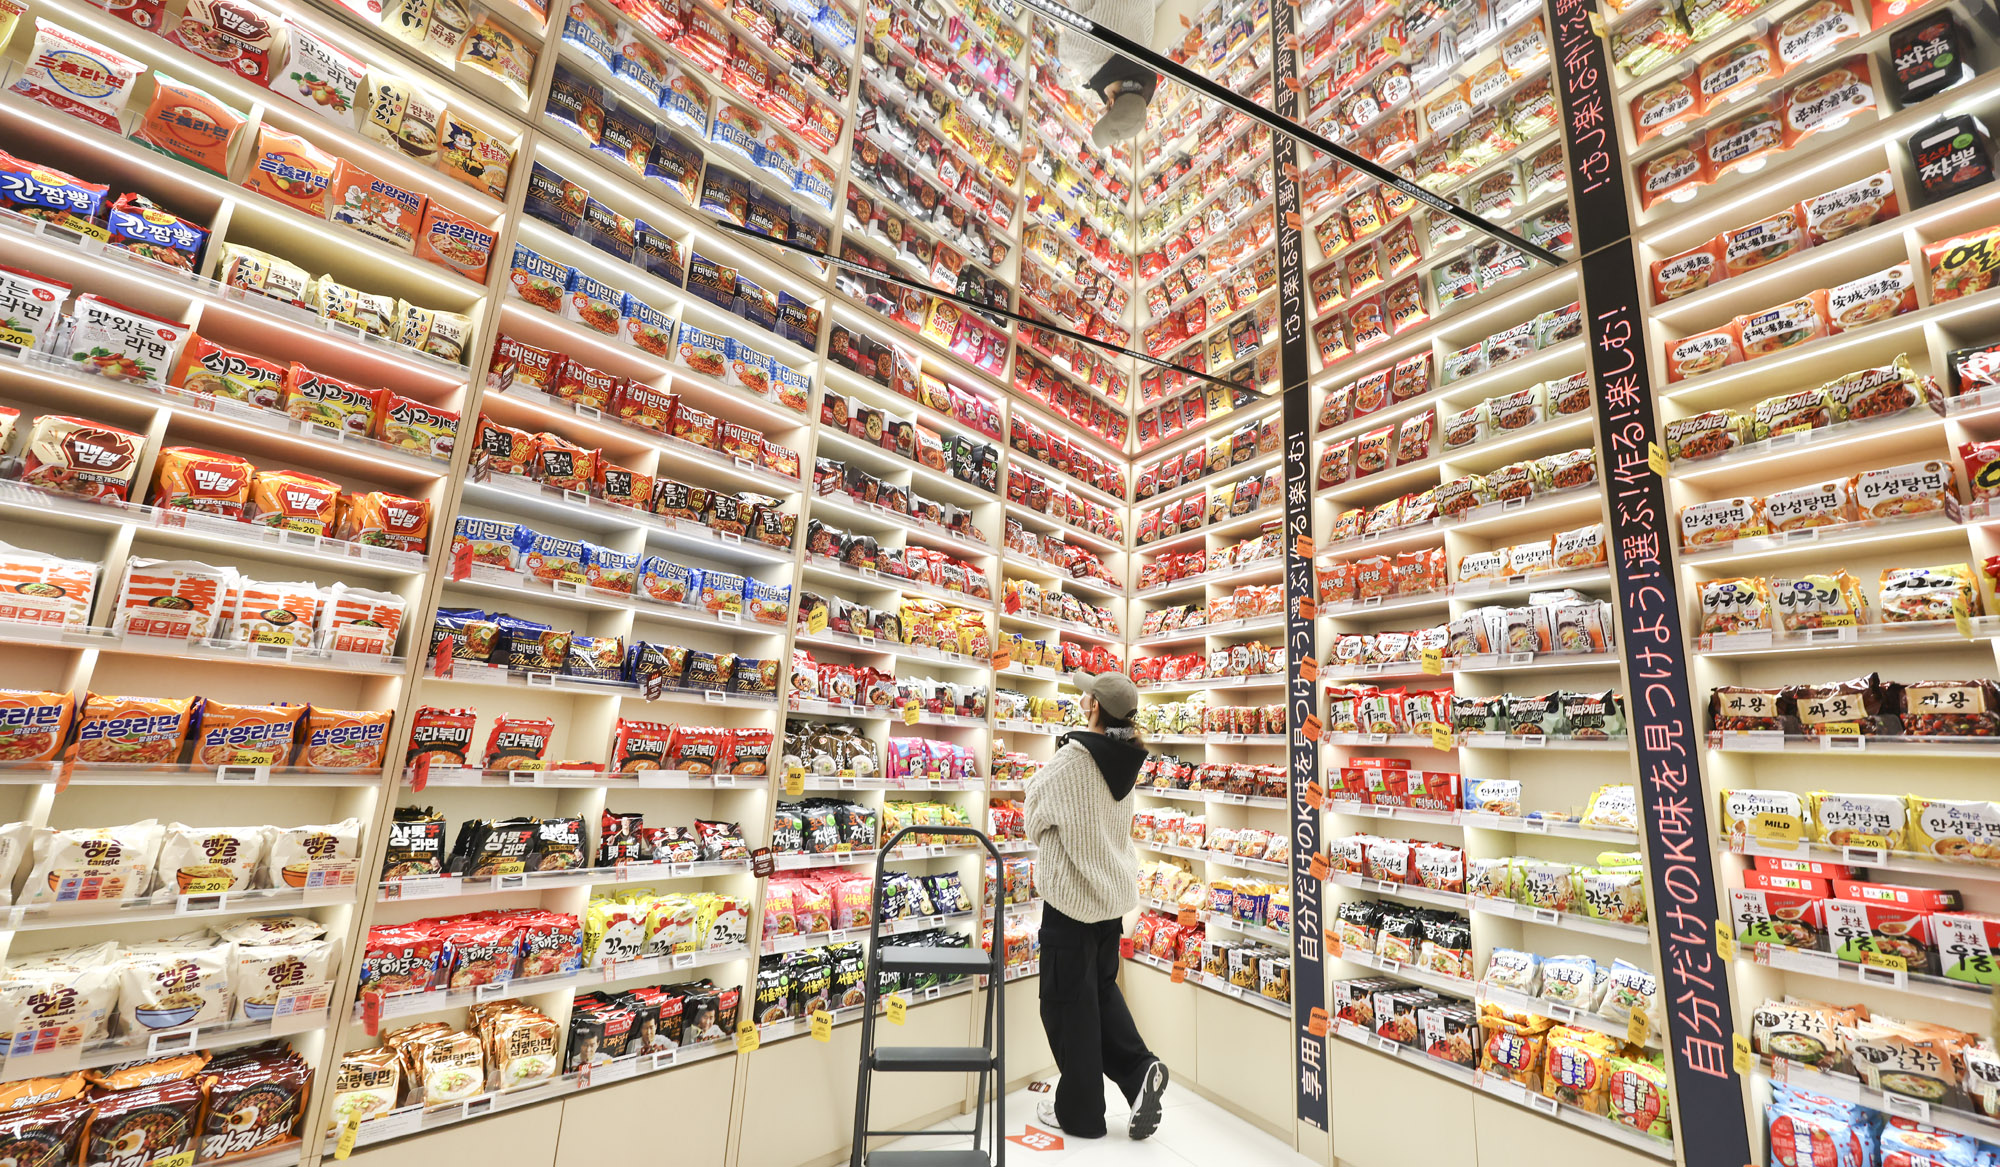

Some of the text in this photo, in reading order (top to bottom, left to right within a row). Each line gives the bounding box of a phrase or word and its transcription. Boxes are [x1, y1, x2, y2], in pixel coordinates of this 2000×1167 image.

[219, 7, 259, 35] 맵탱
[298, 38, 358, 95] 맛있는 라면
[409, 102, 437, 124] 짬뽕
[1920, 147, 1977, 181] 짬뽕
[0, 173, 93, 211] 간짬뽕
[370, 180, 420, 211] 삼양라면
[115, 216, 195, 248] 간짬뽕
[431, 221, 494, 247] 삼양라면
[526, 254, 568, 286] 비빔면
[584, 280, 623, 311] 비빔면
[435, 320, 463, 340] 짬뽕
[639, 306, 672, 336] 비빔면
[87, 307, 167, 361] 맛있는 라면
[690, 330, 726, 355] 비빔면
[509, 343, 550, 371] 비빔면
[743, 351, 773, 377] 비빔면
[201, 351, 283, 390] 쇠고기면
[573, 367, 612, 392] 비빔면
[301, 377, 373, 413] 쇠고기면
[1830, 364, 1901, 404] 짜파게티
[634, 388, 672, 414] 비빔면
[1756, 392, 1826, 423] 짜파게티
[390, 402, 460, 433] 쇠고기면
[1667, 412, 1728, 440] 짜파게티
[74, 440, 124, 468] 맵탱
[194, 468, 237, 494] 맵탱
[1863, 474, 1941, 499] 안성탕면
[286, 490, 324, 513] 맵탱
[1769, 493, 1839, 517] 안성탕면
[388, 505, 421, 529] 맵탱
[1684, 509, 1746, 528] 안성탕면
[466, 519, 516, 543] 비빔면
[541, 535, 584, 559] 비빔면
[601, 549, 637, 572] 비빔면
[712, 572, 745, 593] 비빔면
[1702, 589, 1756, 607] 너구리
[1777, 587, 1841, 607] 너구리
[1425, 654, 1438, 662] MILD
[1453, 704, 1491, 719] 짜파게티
[1508, 699, 1550, 716] 짜파게티
[1564, 702, 1606, 719] 짜파게티
[1728, 698, 1766, 712] 짜왕
[1806, 698, 1852, 718] 짜왕
[80, 714, 182, 739] 삼양라면
[205, 721, 293, 746] 삼양라면
[310, 723, 386, 747] 삼양라면
[422, 726, 470, 745] 라볶이
[1436, 728, 1448, 737] MILD
[506, 733, 546, 750] 라볶이
[690, 742, 720, 762] 라볶이
[1764, 819, 1791, 830] MILD
[1826, 810, 1891, 828] 안성탕면
[1929, 817, 2000, 839] 안성탕면
[80, 838, 125, 860] 탱글
[201, 837, 241, 860] 탱글
[302, 835, 340, 859] 탱글
[411, 838, 439, 852] 라면
[811, 829, 839, 852] 짬뽕
[1314, 857, 1329, 869] MEDIUM
[1421, 859, 1458, 878] 농심라면
[1526, 880, 1559, 904] 칼국수
[1584, 886, 1625, 915] 칼국수
[1737, 913, 1773, 938] 우동
[605, 937, 642, 960] 꼬꼬면
[1834, 926, 1874, 953] 우동
[1945, 943, 1994, 973] 우동
[156, 962, 201, 988] 탱글
[268, 960, 308, 986] 탱글
[1617, 974, 1657, 1000] 백짬뽕
[27, 988, 79, 1014] 탱글
[891, 1001, 903, 1010] MILD
[816, 1017, 829, 1026] MILD
[1311, 1012, 1328, 1022] MEDIUM
[1633, 1014, 1645, 1026] MILD
[1780, 1010, 1829, 1034] 칼국수
[741, 1026, 754, 1036] MILD
[510, 1037, 553, 1060] 설렁탕면
[1736, 1042, 1749, 1054] MILD
[1885, 1043, 1942, 1072] 칼국수
[336, 1065, 391, 1092] 설렁탕면
[202, 1119, 294, 1159] 짜짜로니
[1021, 1134, 1051, 1150] 02
